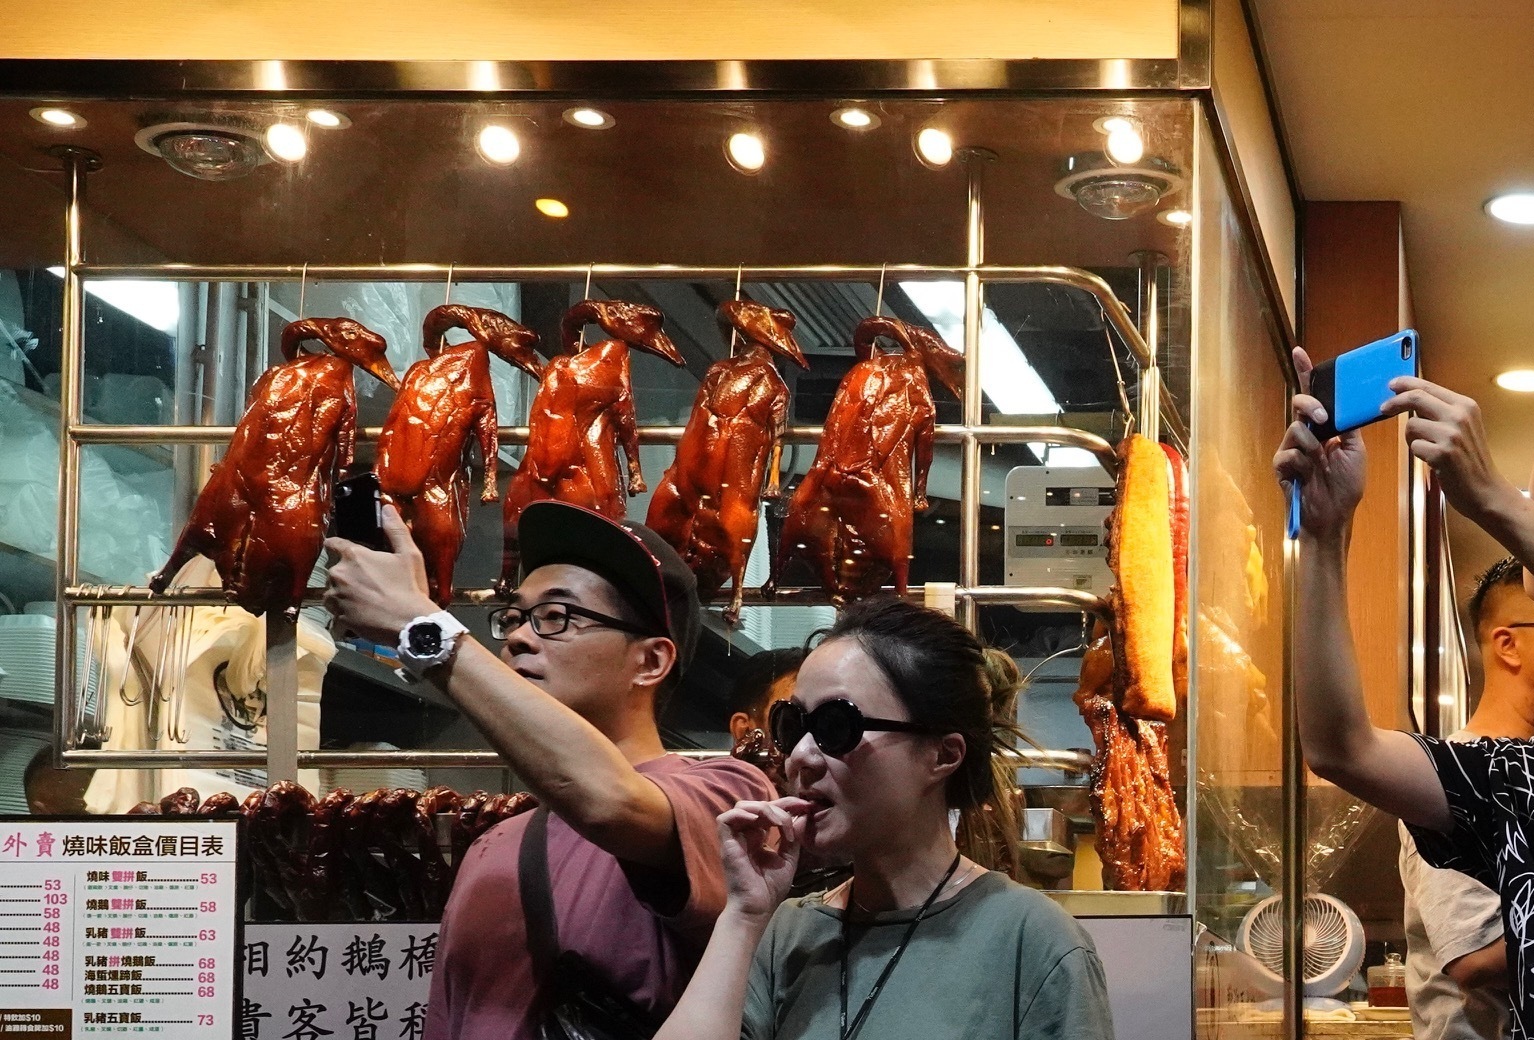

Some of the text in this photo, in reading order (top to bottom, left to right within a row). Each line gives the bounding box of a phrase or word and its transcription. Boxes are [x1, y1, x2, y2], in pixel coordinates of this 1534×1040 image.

[4, 831, 224, 857] 外賣 燒味飯盒價目表
[200, 873, 217, 884] 53
[43, 893, 68, 905] 103
[200, 901, 217, 912] 58
[199, 930, 216, 941] 63
[198, 958, 215, 969] 68
[198, 972, 215, 983] 68
[197, 986, 215, 998] 68
[197, 1014, 214, 1026] 73
